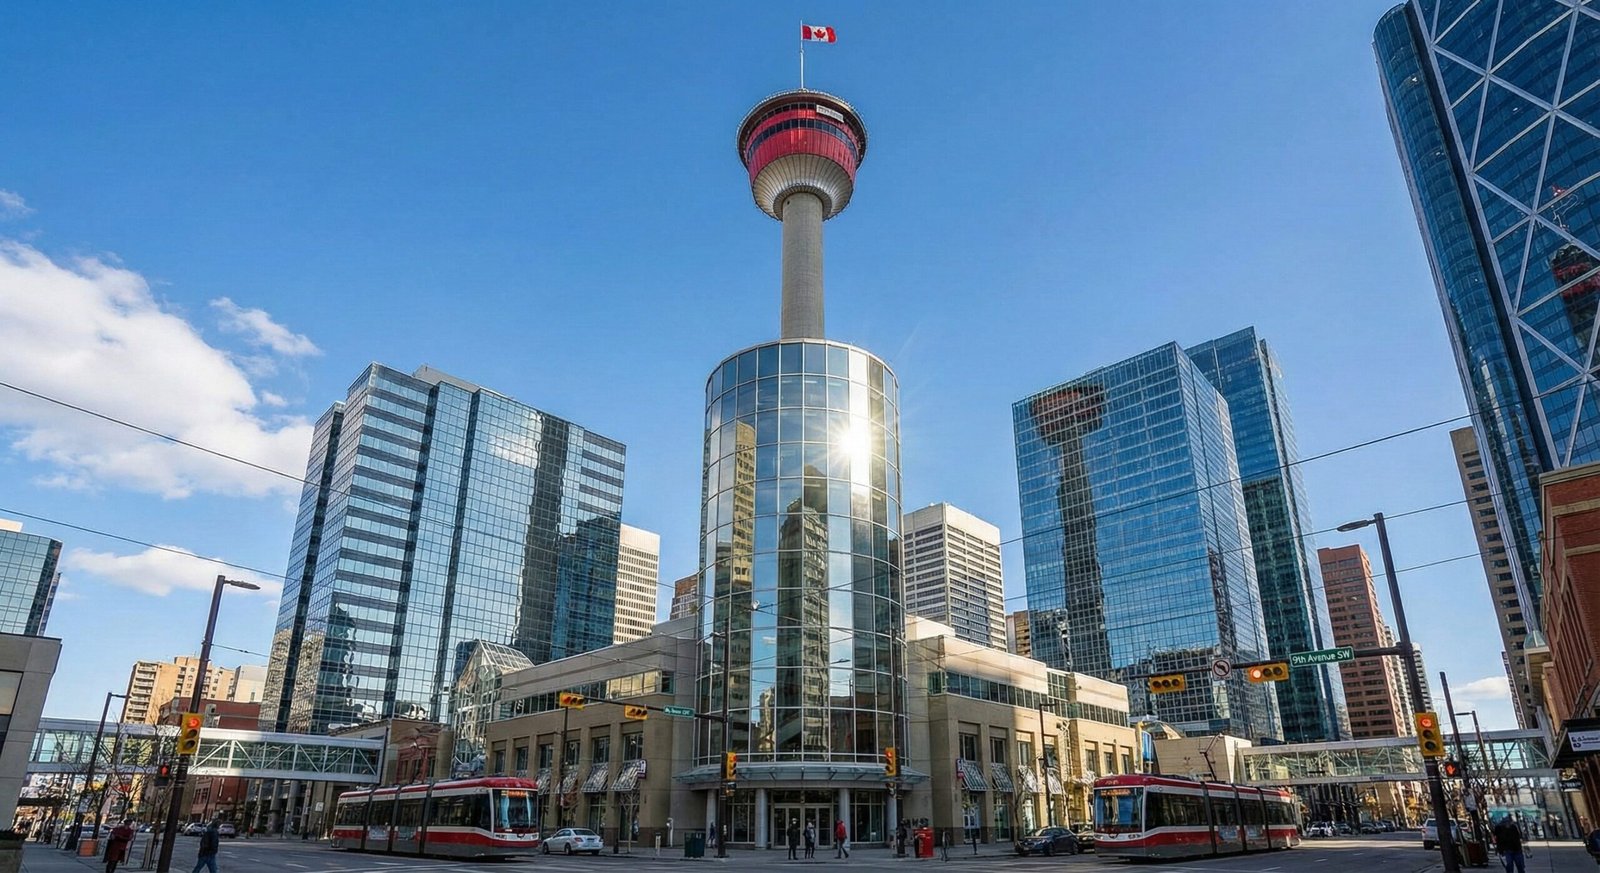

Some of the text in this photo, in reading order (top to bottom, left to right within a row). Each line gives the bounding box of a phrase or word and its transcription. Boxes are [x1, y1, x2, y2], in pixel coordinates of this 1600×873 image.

[1292, 650, 1350, 664] 9th Avenue SW
